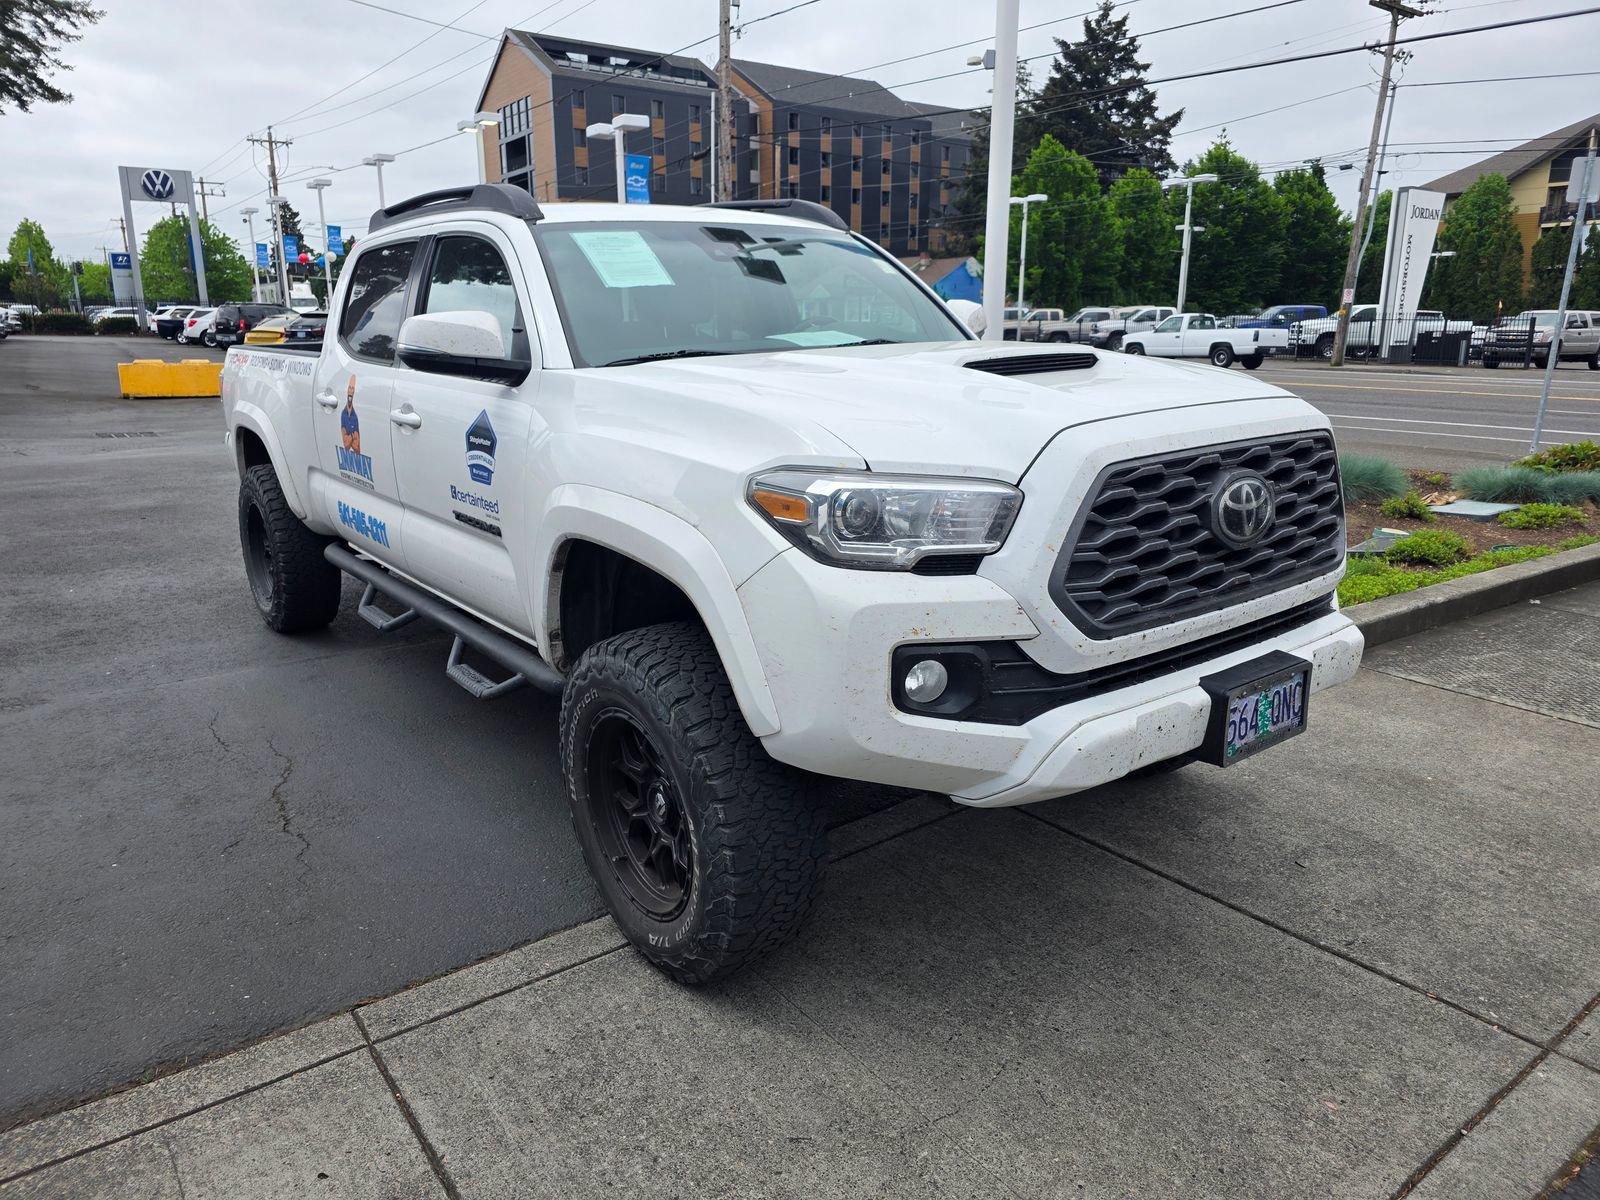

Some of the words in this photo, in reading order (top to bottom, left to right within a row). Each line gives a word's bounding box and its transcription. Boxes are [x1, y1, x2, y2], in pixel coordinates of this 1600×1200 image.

[142, 169, 176, 199] VW
[1410, 204, 1440, 220] JORDAN
[251, 354, 268, 369] ROOFING
[287, 360, 313, 377] WINDOWS
[457, 490, 499, 514] certainteed
[452, 510, 502, 537] TACOMA
[1227, 698, 1260, 746] 564
[1271, 681, 1303, 726] QNC
[648, 932, 671, 948] T/A
